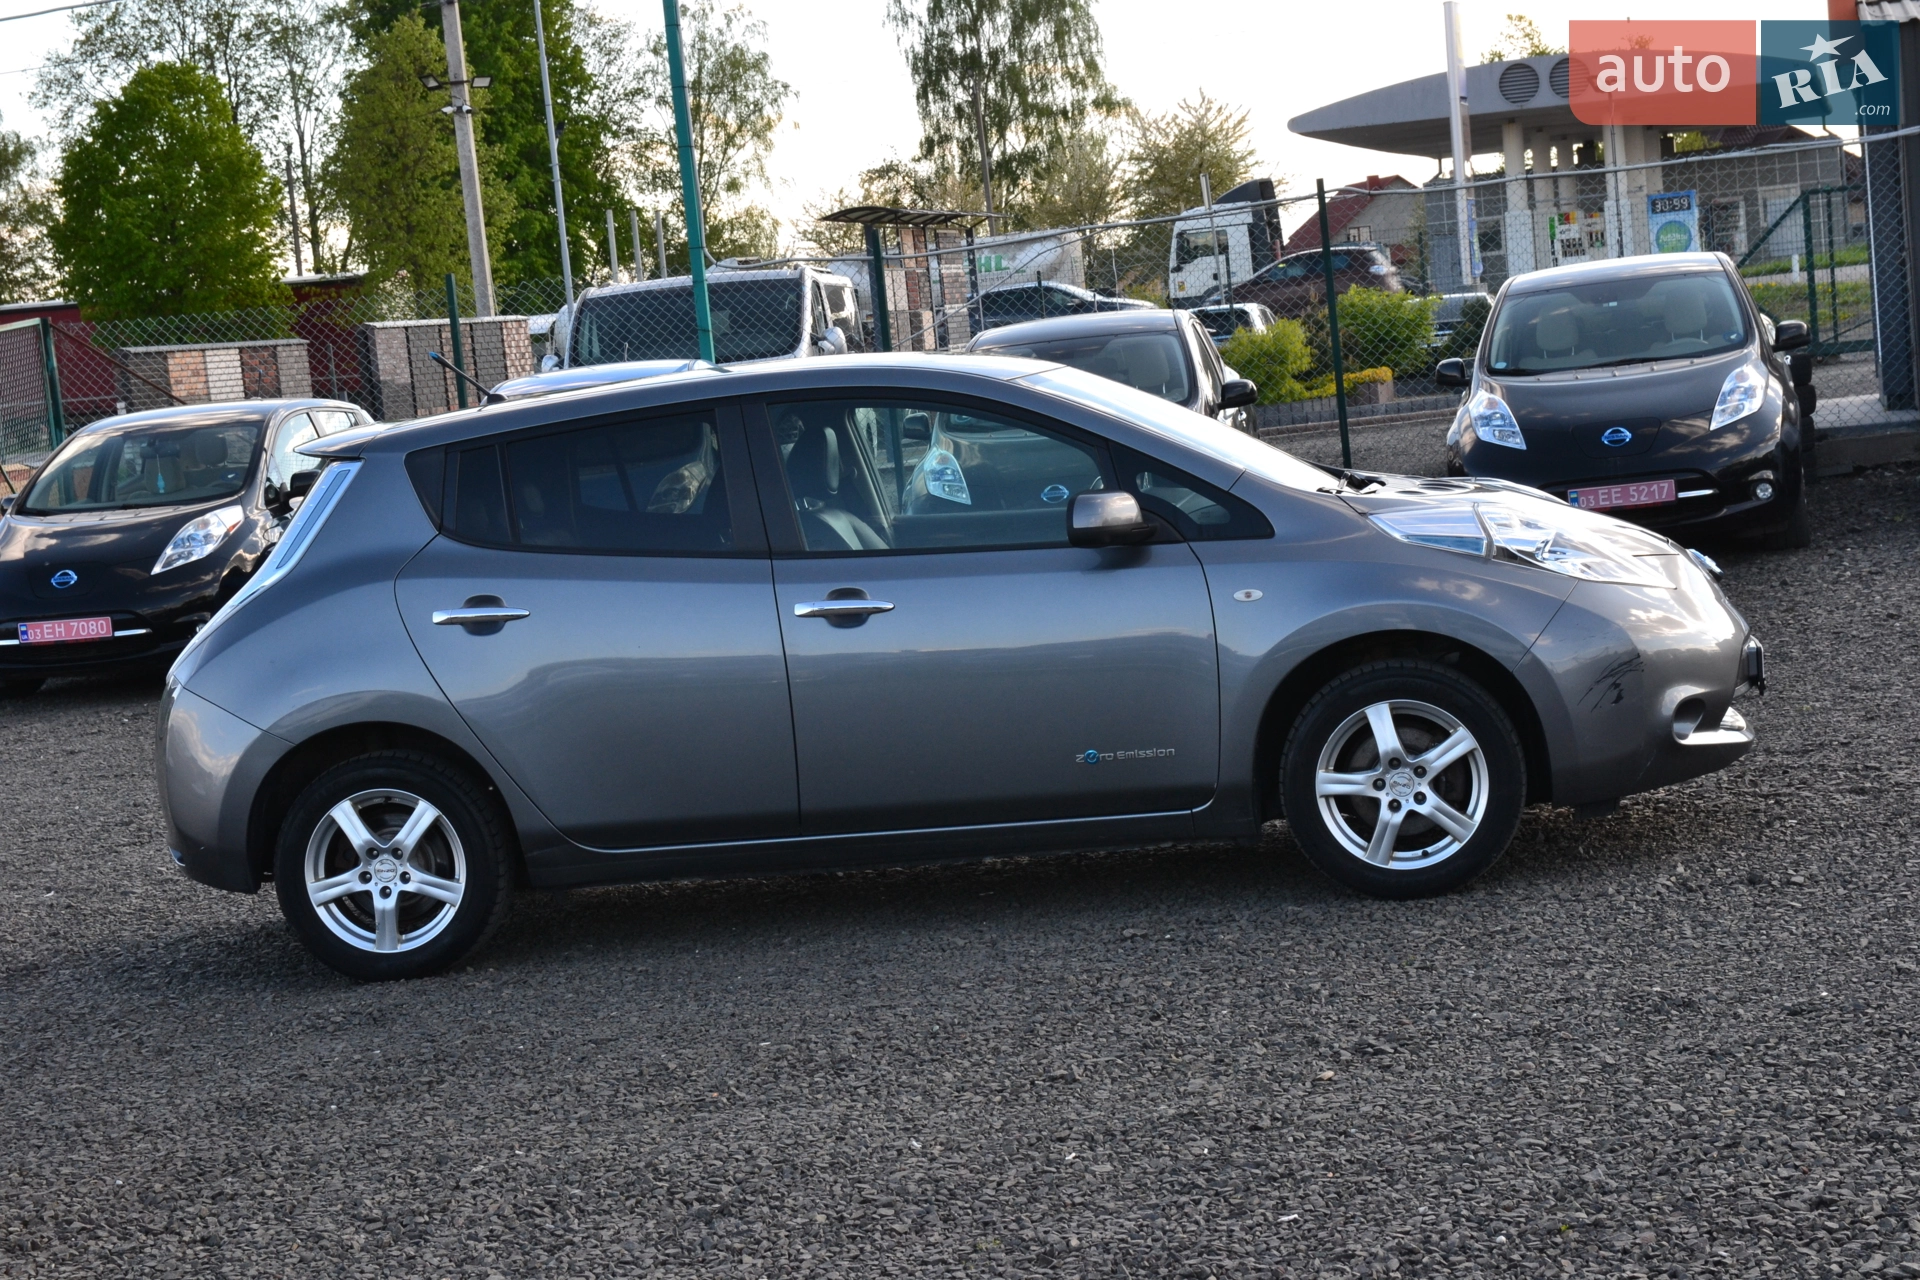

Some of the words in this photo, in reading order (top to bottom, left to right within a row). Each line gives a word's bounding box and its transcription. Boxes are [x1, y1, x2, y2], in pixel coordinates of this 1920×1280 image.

[1580, 496, 1595, 507] 03
[1598, 487, 1623, 505] EE
[1629, 483, 1669, 502] 5217
[29, 629, 41, 640] 03
[43, 623, 65, 639] EH
[69, 620, 107, 636] 7080
